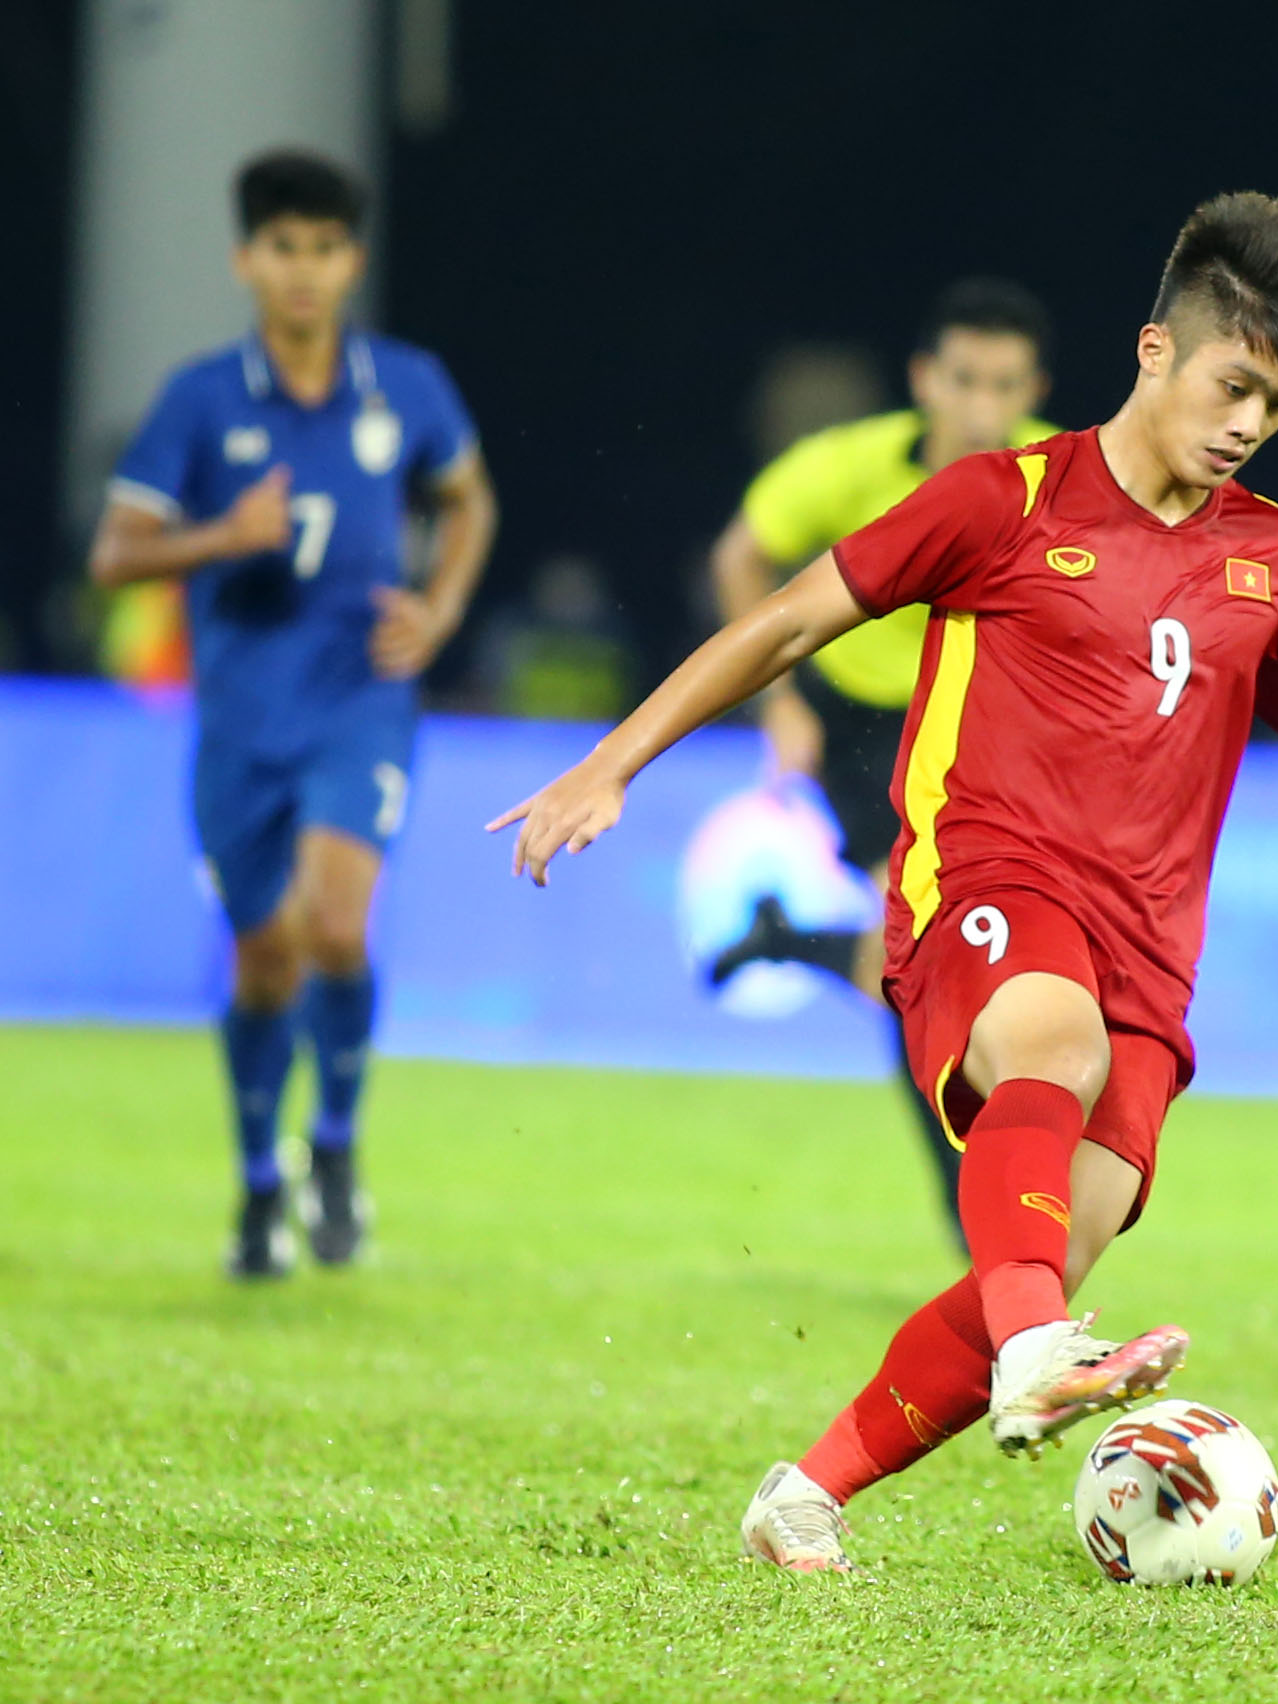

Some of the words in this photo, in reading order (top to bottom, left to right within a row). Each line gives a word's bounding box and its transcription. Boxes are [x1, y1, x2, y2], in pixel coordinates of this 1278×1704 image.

[290, 494, 335, 577] 7
[1151, 617, 1192, 716] 9
[960, 905, 1009, 964] 9
